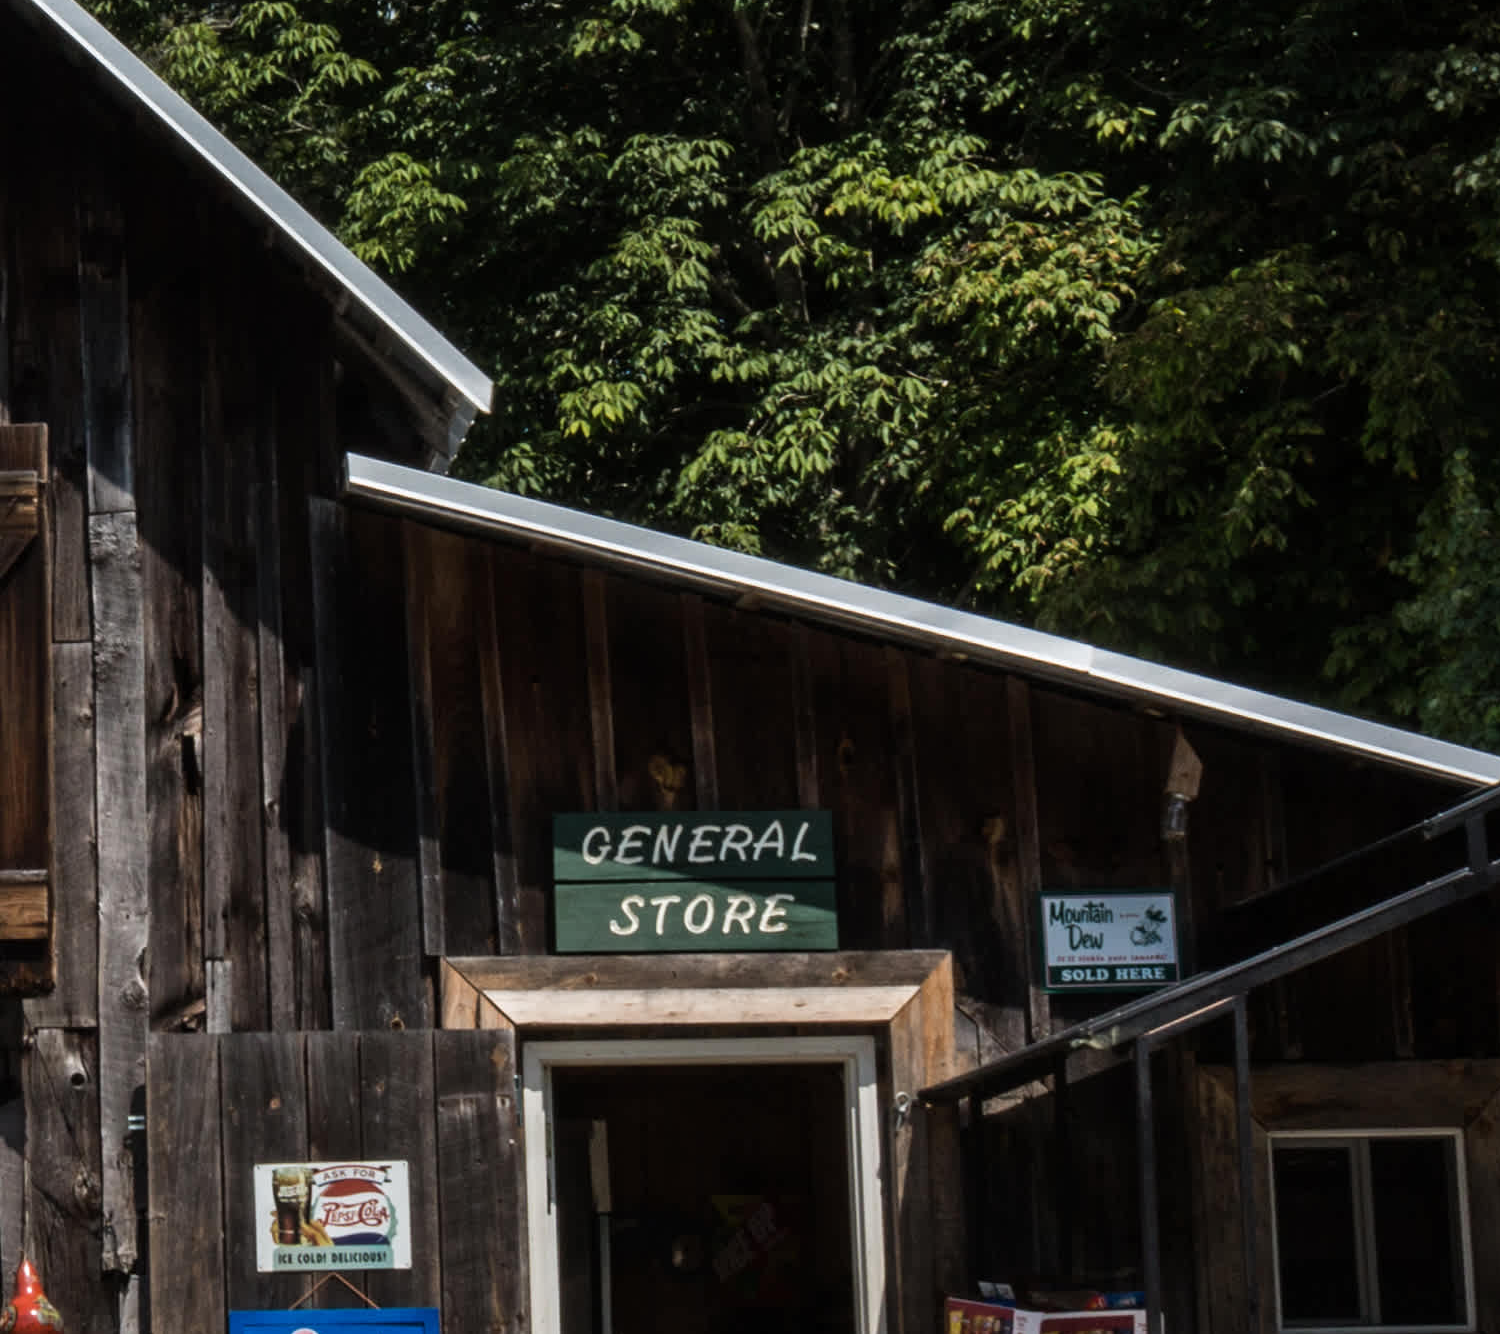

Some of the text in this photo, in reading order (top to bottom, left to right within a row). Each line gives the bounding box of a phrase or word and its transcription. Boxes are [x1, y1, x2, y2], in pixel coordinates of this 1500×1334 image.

[582, 820, 817, 865] GENERAL
[609, 894, 795, 936] STORE
[1049, 901, 1114, 926] Mountain
[1064, 924, 1104, 951] Dew
[1060, 967, 1167, 982] SOLD HERE
[323, 1169, 376, 1180] ASK FOR
[278, 1253, 293, 1265] ICE
